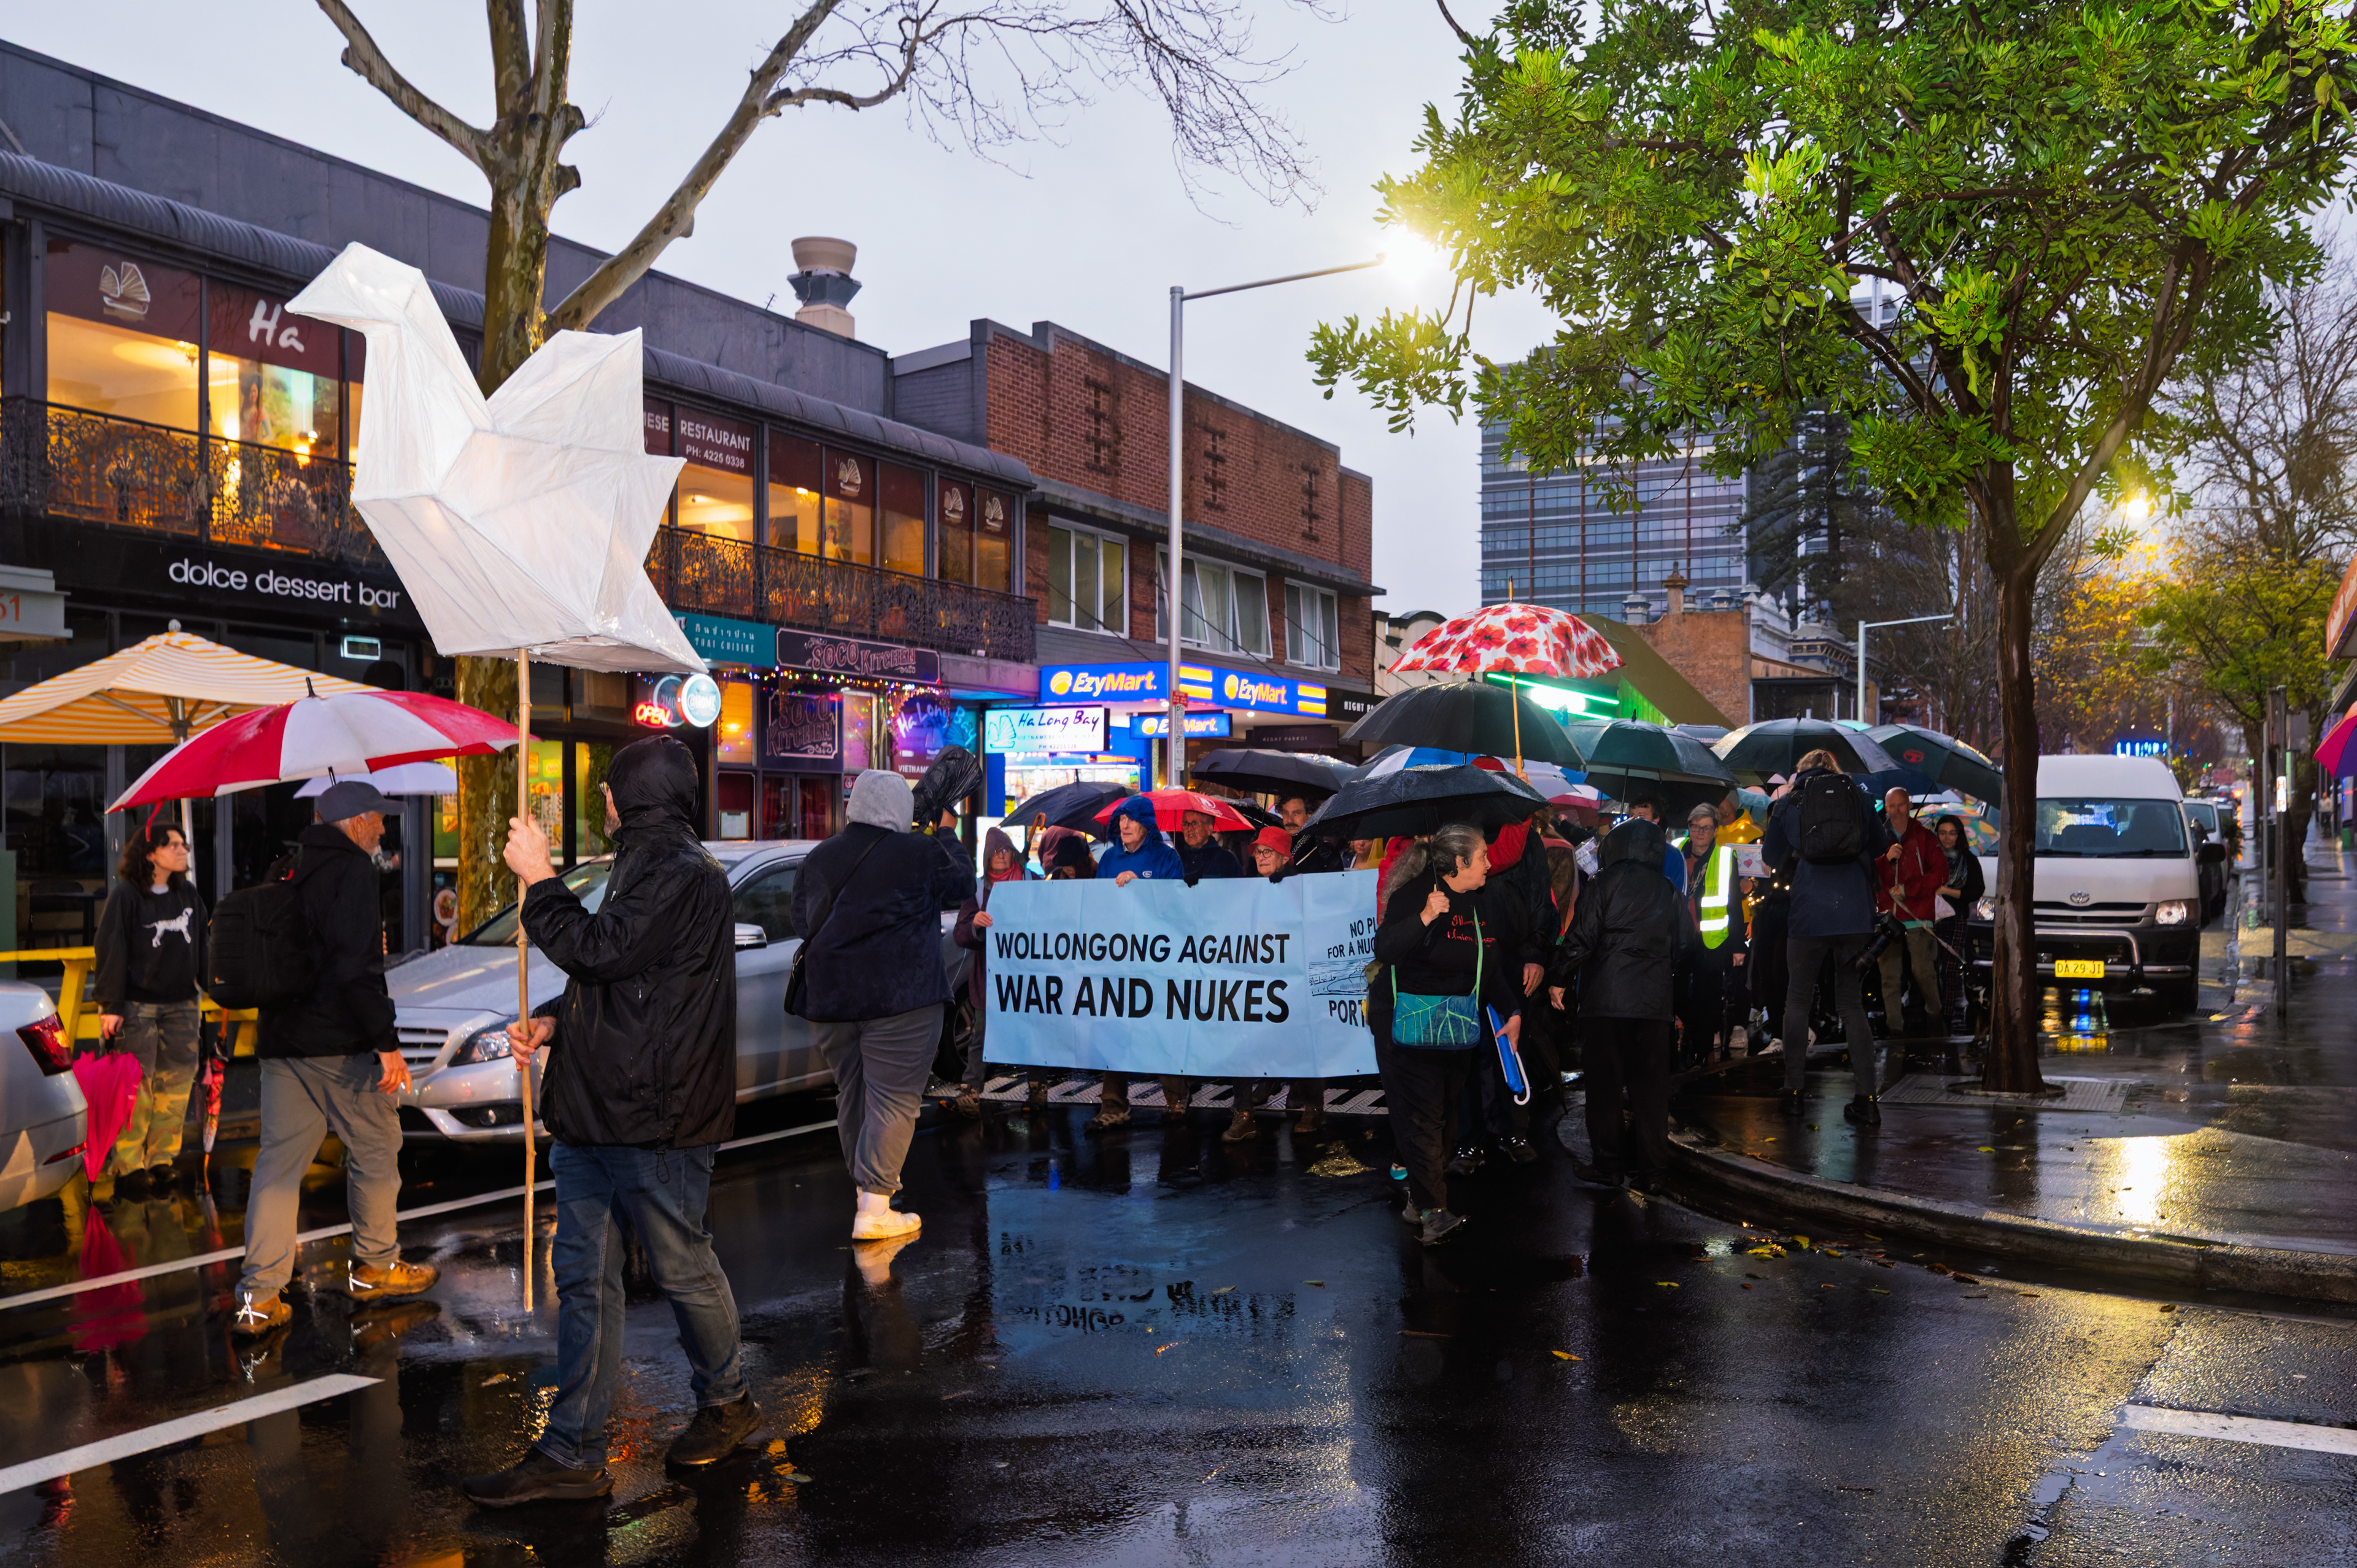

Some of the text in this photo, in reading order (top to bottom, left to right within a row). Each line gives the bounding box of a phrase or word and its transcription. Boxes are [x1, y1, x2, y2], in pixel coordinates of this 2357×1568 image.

[249, 299, 304, 353] Ha
[681, 420, 751, 451] RESTAURANT
[686, 444, 702, 458] PH:
[726, 455, 745, 468] 0338
[169, 558, 401, 609] dolce dessert bar
[695, 637, 716, 648] THAI
[812, 641, 916, 675] SOCO KITCHEN
[636, 704, 670, 725] OPEN
[778, 695, 829, 728] SOCO
[1344, 701, 1364, 712] NIGHT
[897, 711, 917, 738] Ha
[1018, 710, 1100, 732] Ha Long Bay
[1350, 920, 1364, 938] NO
[995, 933, 1290, 964] WOLLONGONG AGAINST
[1328, 944, 1345, 959] FOR
[1349, 941, 1355, 957] A
[996, 975, 1289, 1023] WAR AND NUKES
